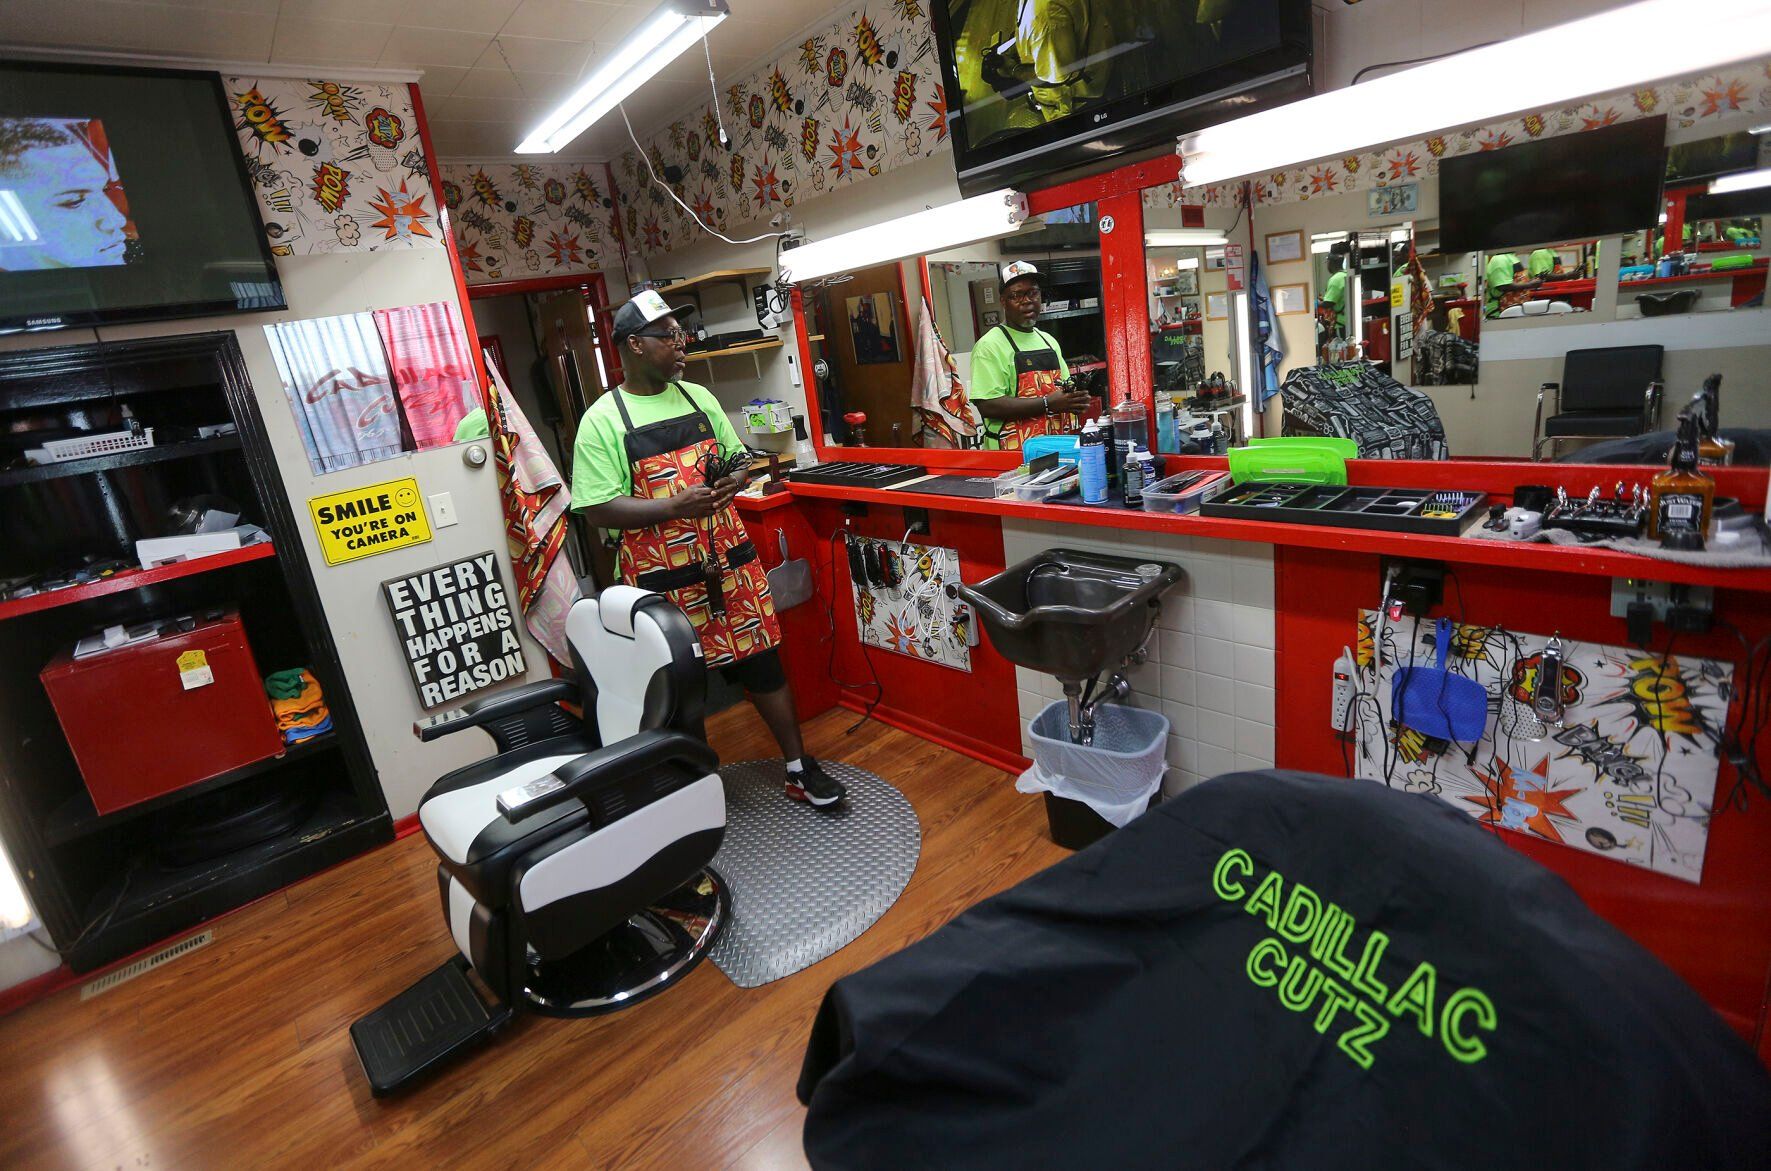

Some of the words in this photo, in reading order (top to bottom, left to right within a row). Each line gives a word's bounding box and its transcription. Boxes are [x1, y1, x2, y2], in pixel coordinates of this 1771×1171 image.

[321, 164, 343, 214] POW!
[26, 317, 62, 326] SAMSUNG
[318, 494, 392, 525] SMILE
[331, 518, 388, 540] YOU'RE
[394, 511, 417, 525] ON
[346, 527, 410, 550] CAMERA
[388, 554, 496, 610] EVERY
[396, 582, 507, 637] THING
[406, 608, 512, 660] HAPPENS
[413, 641, 484, 684] FOR
[501, 629, 521, 654] A
[421, 651, 526, 708] REASON
[1629, 656, 1703, 735] POW
[1213, 848, 1498, 1063] CADILLAC
[1246, 938, 1391, 1070] CUTZ
